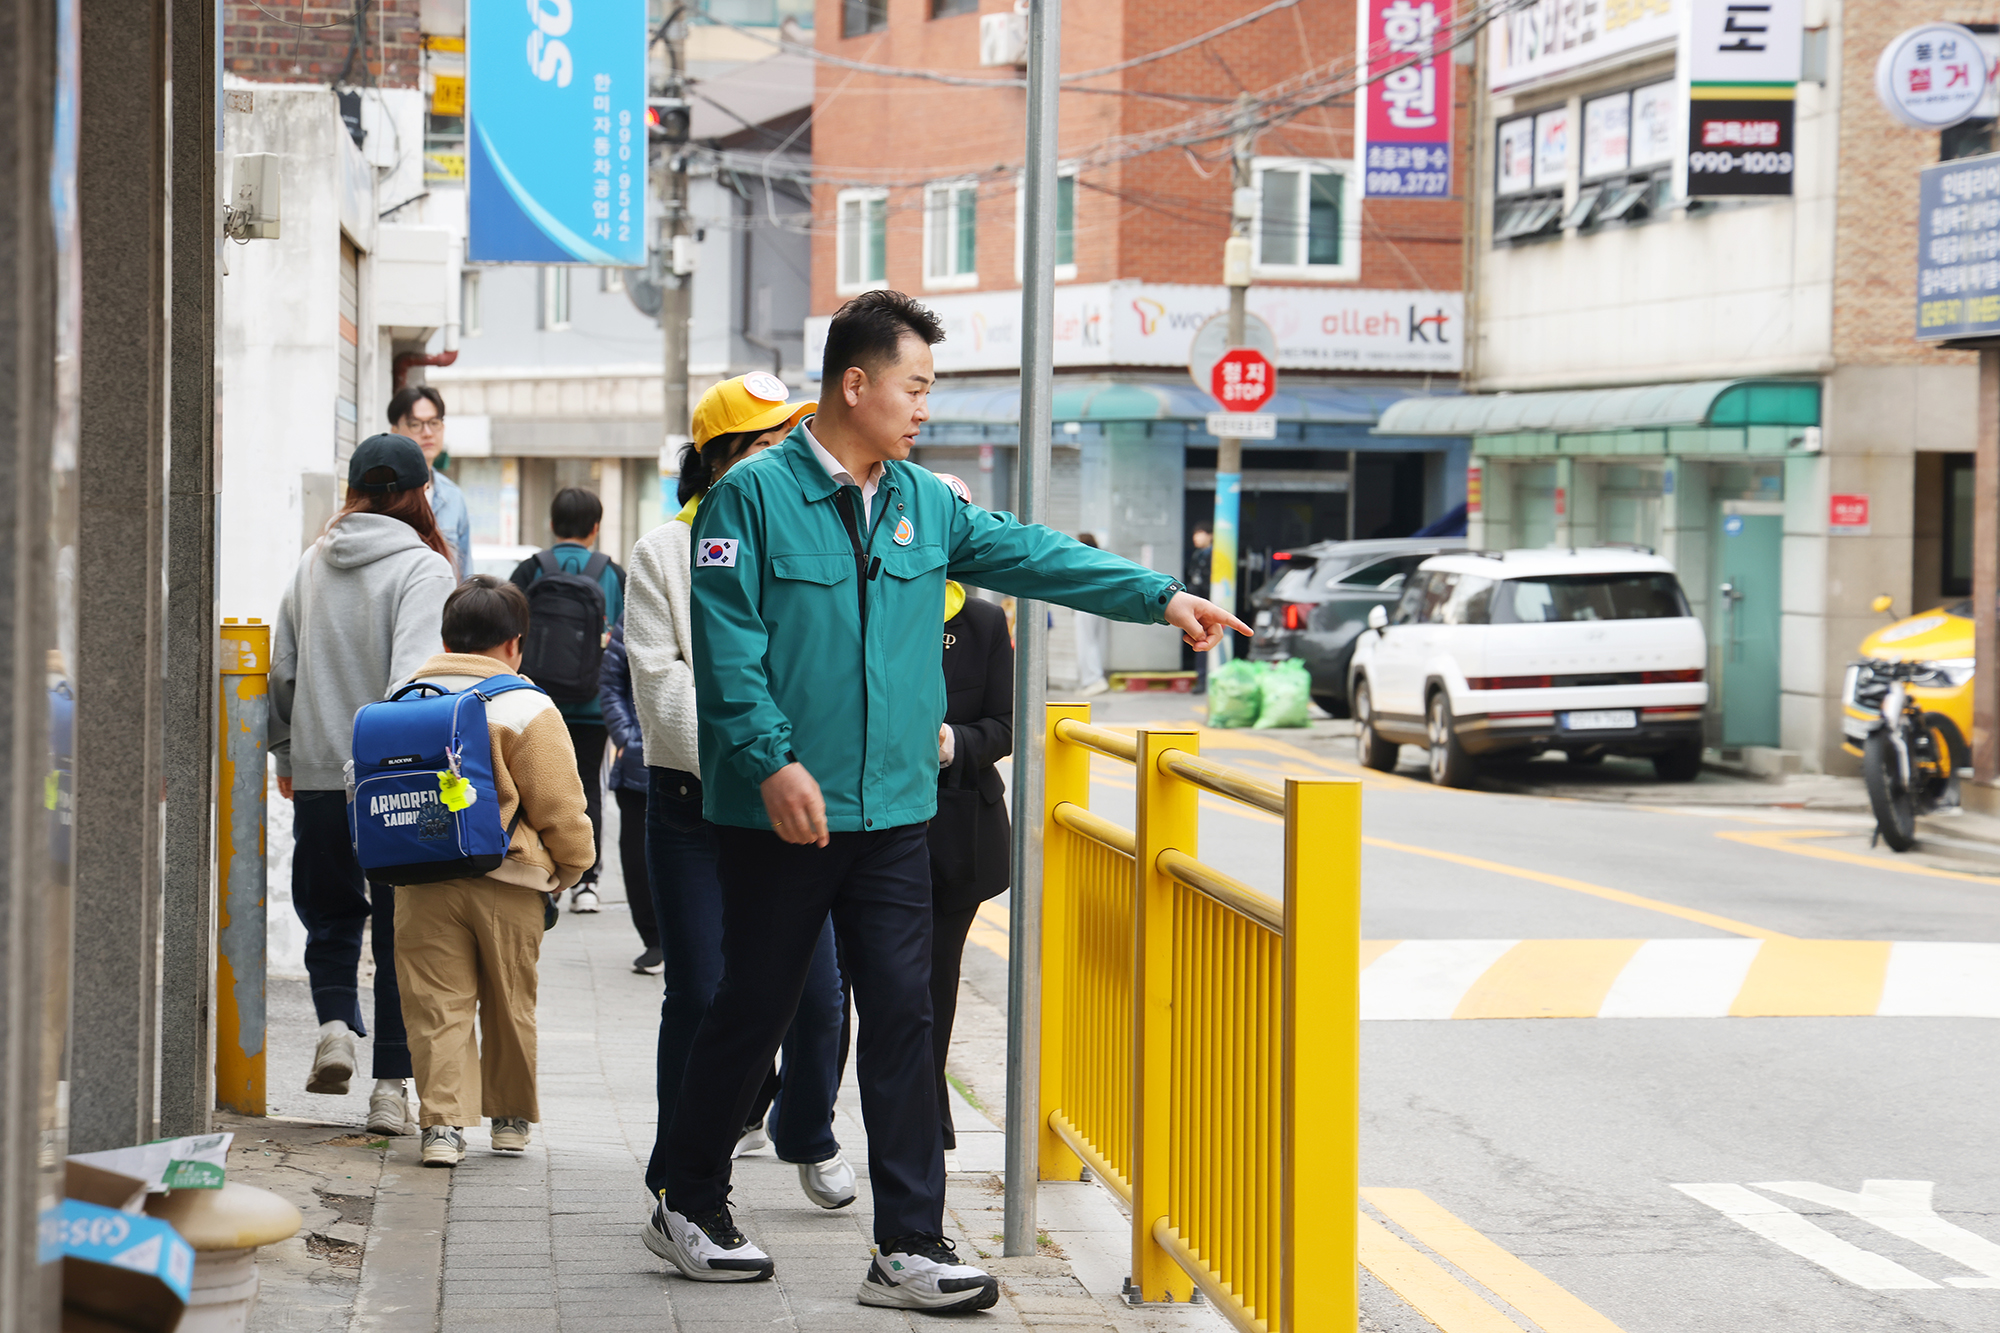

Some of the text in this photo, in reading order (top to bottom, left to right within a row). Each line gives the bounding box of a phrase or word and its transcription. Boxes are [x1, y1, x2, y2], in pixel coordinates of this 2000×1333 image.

[1381, 0, 1440, 129] 학원
[1703, 121, 1779, 145] 교육상담
[592, 73, 611, 241] 한미자동차공업사
[1689, 151, 1794, 174] 990-1003
[1082, 302, 1101, 347] kt
[1321, 305, 1449, 343] olleh kt
[752, 377, 780, 393] 30
[1223, 382, 1266, 401] STOP
[382, 811, 420, 827] SAURU
